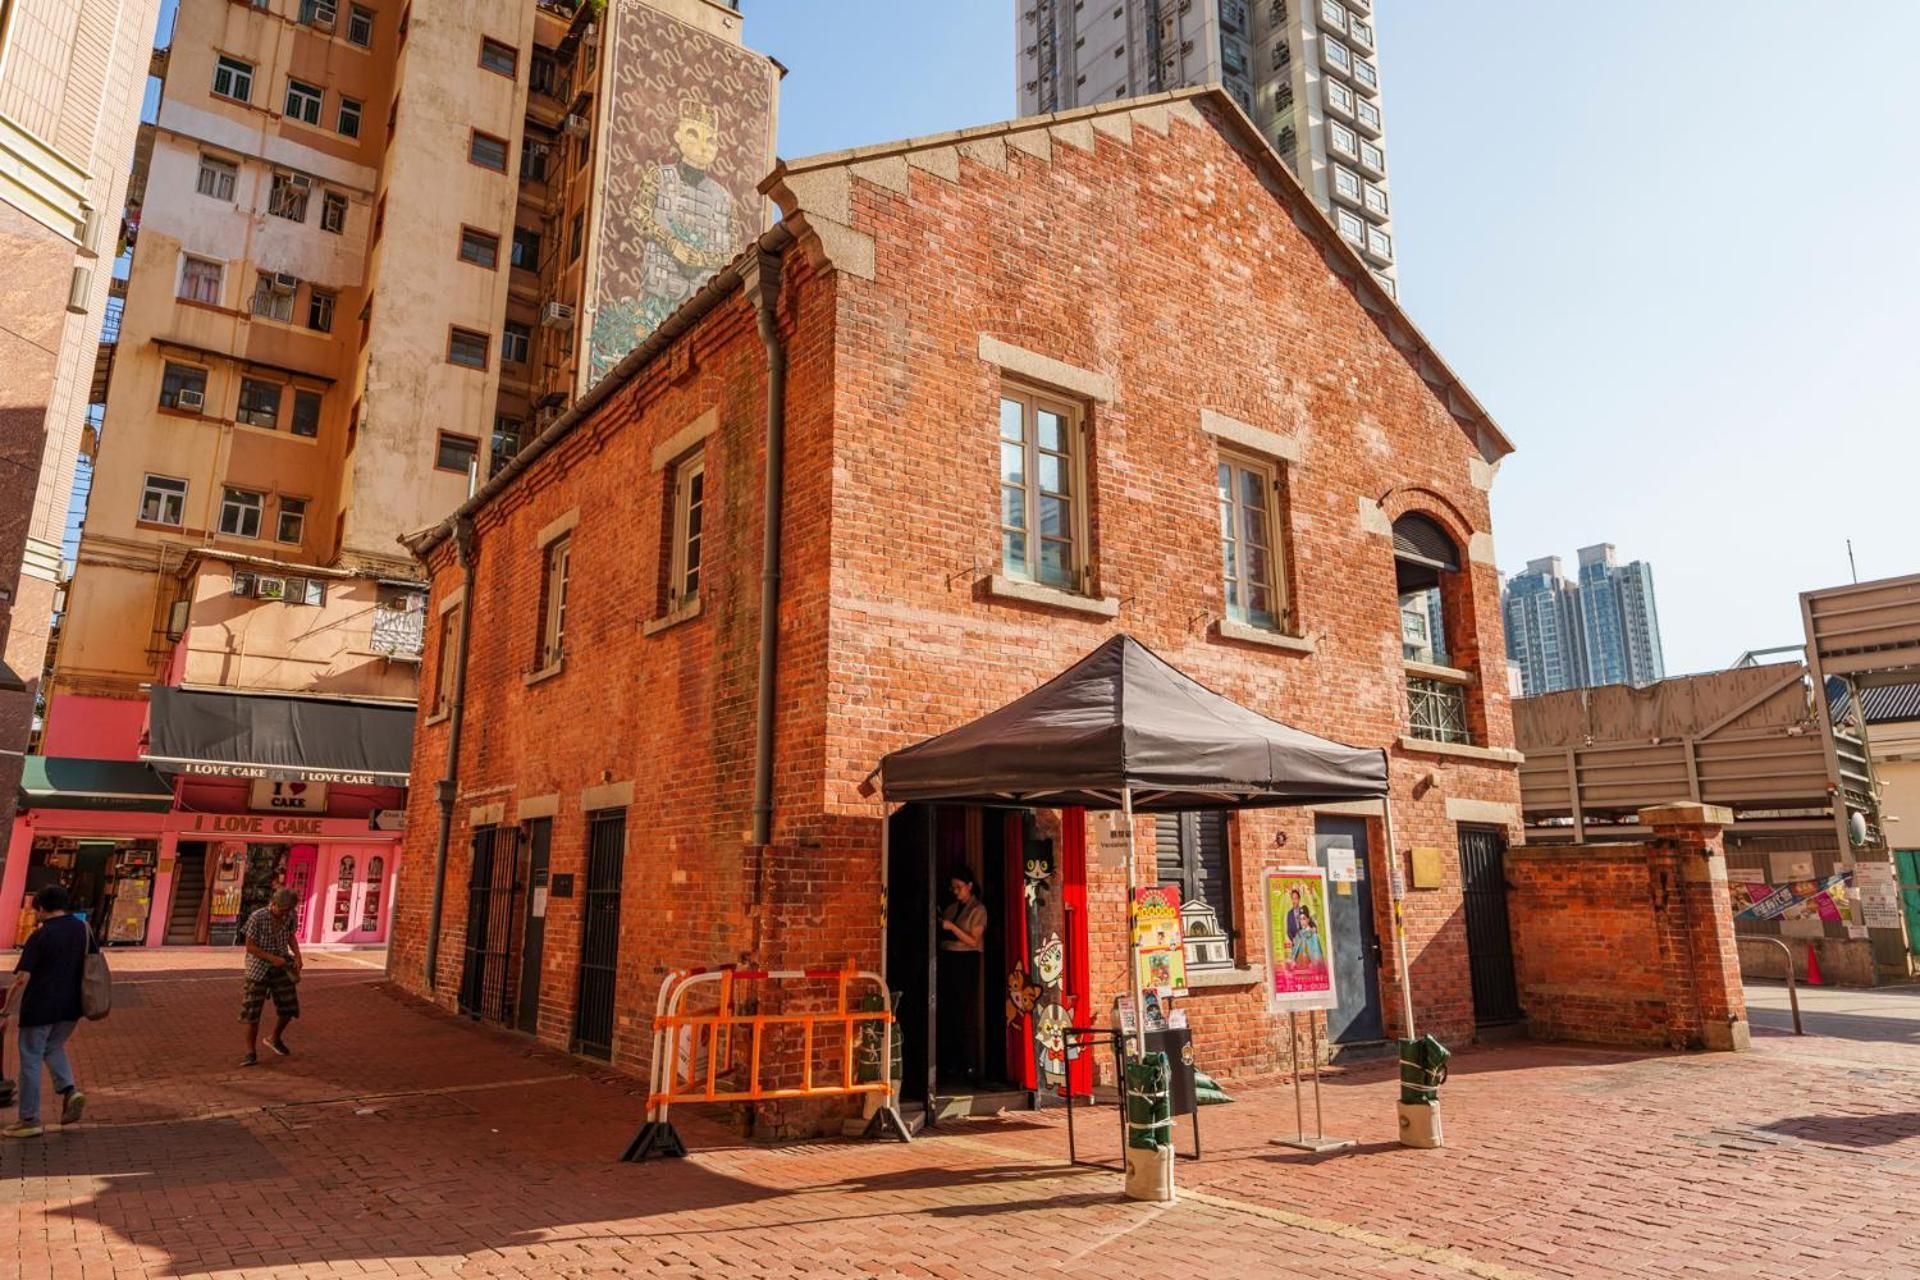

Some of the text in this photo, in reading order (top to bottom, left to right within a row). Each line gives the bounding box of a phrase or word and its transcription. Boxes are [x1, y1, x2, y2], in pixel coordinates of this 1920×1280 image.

[185, 764, 191, 772] I
[195, 764, 229, 776] LOVE
[232, 767, 267, 778] CAKE
[301, 772, 306, 780] I
[309, 772, 341, 783] LOVE
[343, 775, 375, 785] CAKE
[274, 782, 282, 795] I
[271, 797, 306, 808] CAKE
[195, 815, 322, 834] I LOVE CAKE
